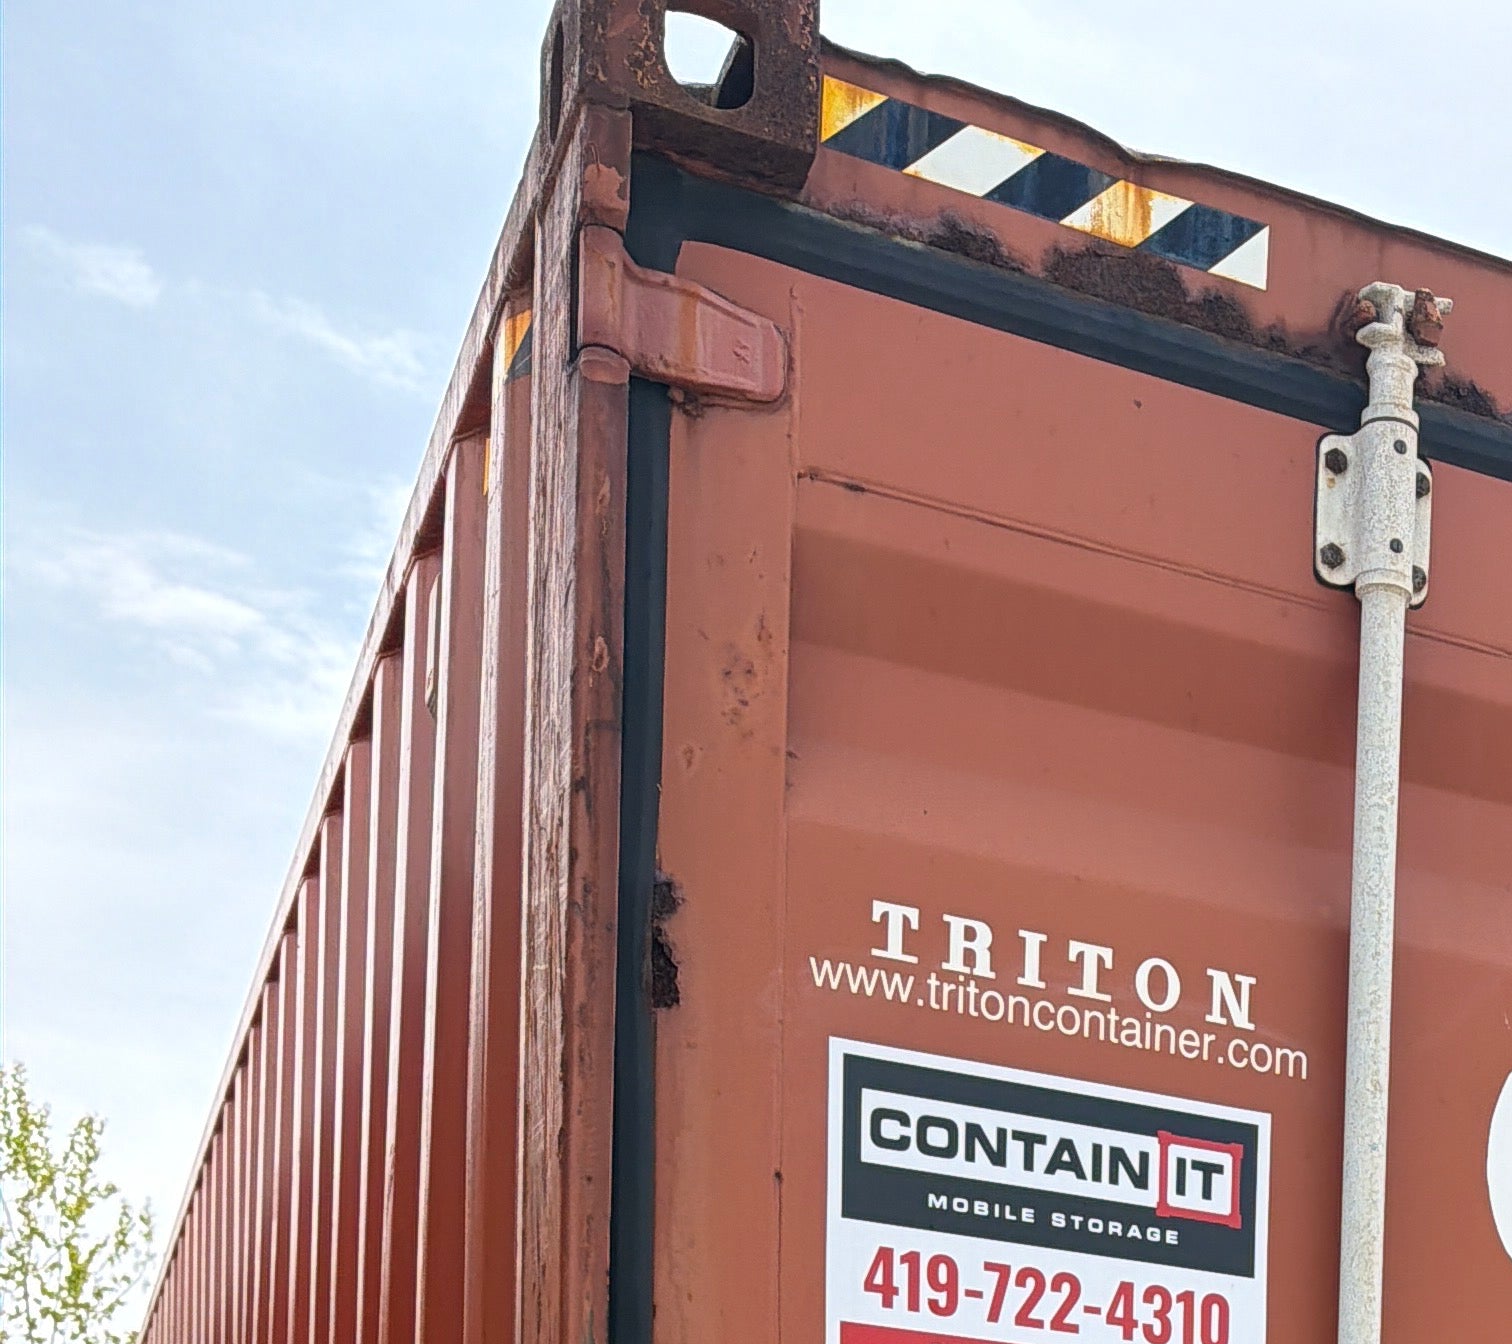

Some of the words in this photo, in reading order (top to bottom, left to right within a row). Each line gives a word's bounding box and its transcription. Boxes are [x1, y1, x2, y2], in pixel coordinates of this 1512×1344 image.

[809, 956, 1309, 1079] www.tritoncontainer.com
[871, 900, 1256, 1030] TRITON
[870, 1106, 1150, 1191] CONTAIN
[1175, 1157, 1224, 1201] IT
[928, 1194, 1036, 1223] MOBILE
[1051, 1213, 1180, 1245] STORAGE
